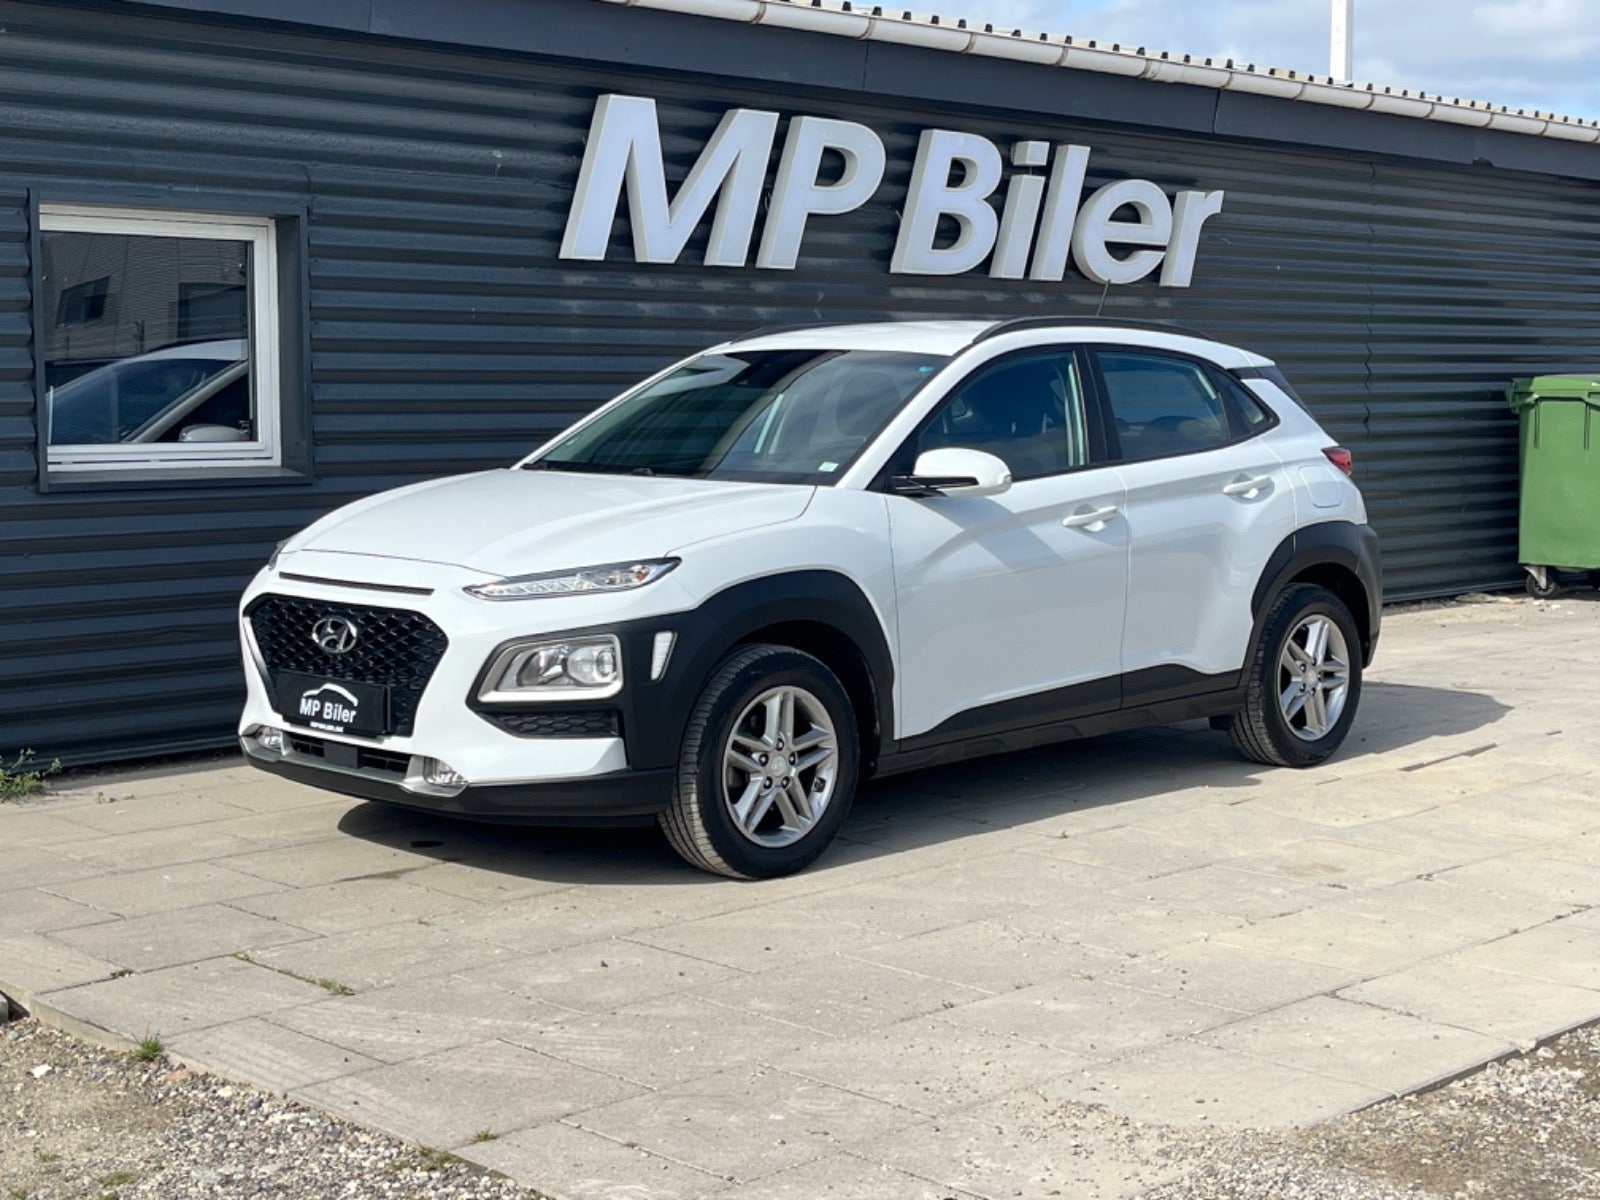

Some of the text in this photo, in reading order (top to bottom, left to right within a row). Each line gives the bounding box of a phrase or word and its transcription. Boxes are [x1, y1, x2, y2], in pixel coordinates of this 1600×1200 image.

[559, 93, 1224, 288] MP Biler
[300, 698, 357, 723] MP Biler
